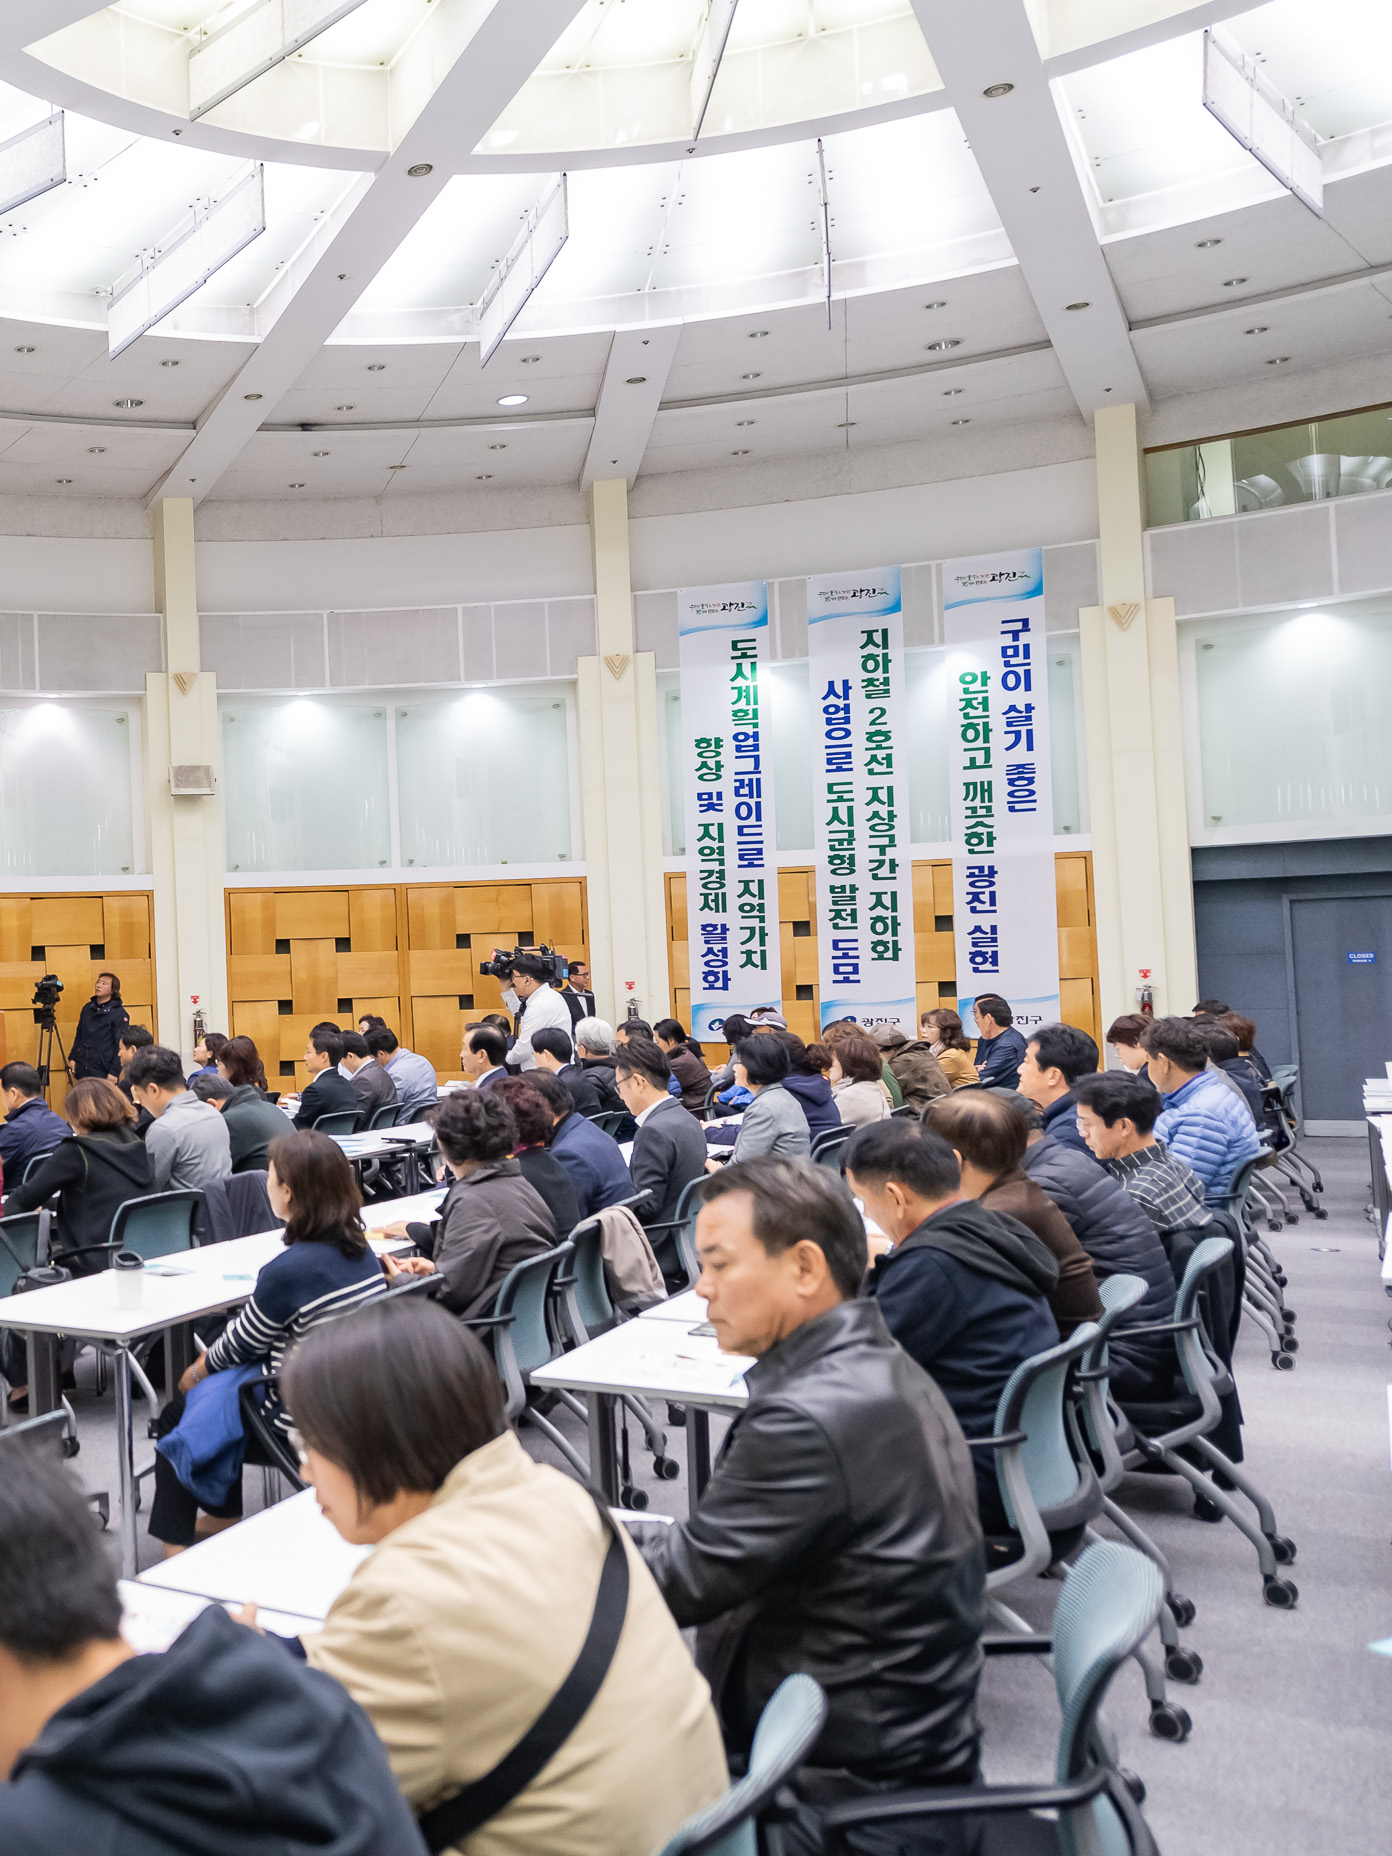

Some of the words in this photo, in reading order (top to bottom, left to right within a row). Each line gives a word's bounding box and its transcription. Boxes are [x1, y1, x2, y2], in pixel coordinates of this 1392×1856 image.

[720, 601, 746, 612] 광진
[851, 588, 877, 600] 광진
[990, 571, 1018, 583] 광진
[859, 628, 892, 700] 지하철
[999, 618, 1033, 693] 구민이
[729, 638, 766, 869] 도시계획업그레이드로
[820, 679, 855, 774] 사업으로
[863, 706, 895, 777] 2호선
[958, 670, 993, 771] 안전하고
[1001, 703, 1036, 753] 살기
[694, 736, 724, 782] 향상
[1005, 763, 1038, 813] 좋은
[696, 791, 724, 814] 및
[825, 781, 857, 876] 도시균형
[865, 785, 899, 881] 지상구간
[961, 780, 997, 856] 깨끗한
[696, 822, 728, 914] 지역경제
[964, 864, 998, 915] 광진
[736, 878, 769, 971] 지역가치
[827, 884, 859, 931] 발전
[868, 890, 903, 962] 지하화
[700, 923, 732, 992] 활성화
[831, 938, 862, 985] 도모
[966, 923, 1000, 974] 실현
[861, 1017, 901, 1028] 광진구
